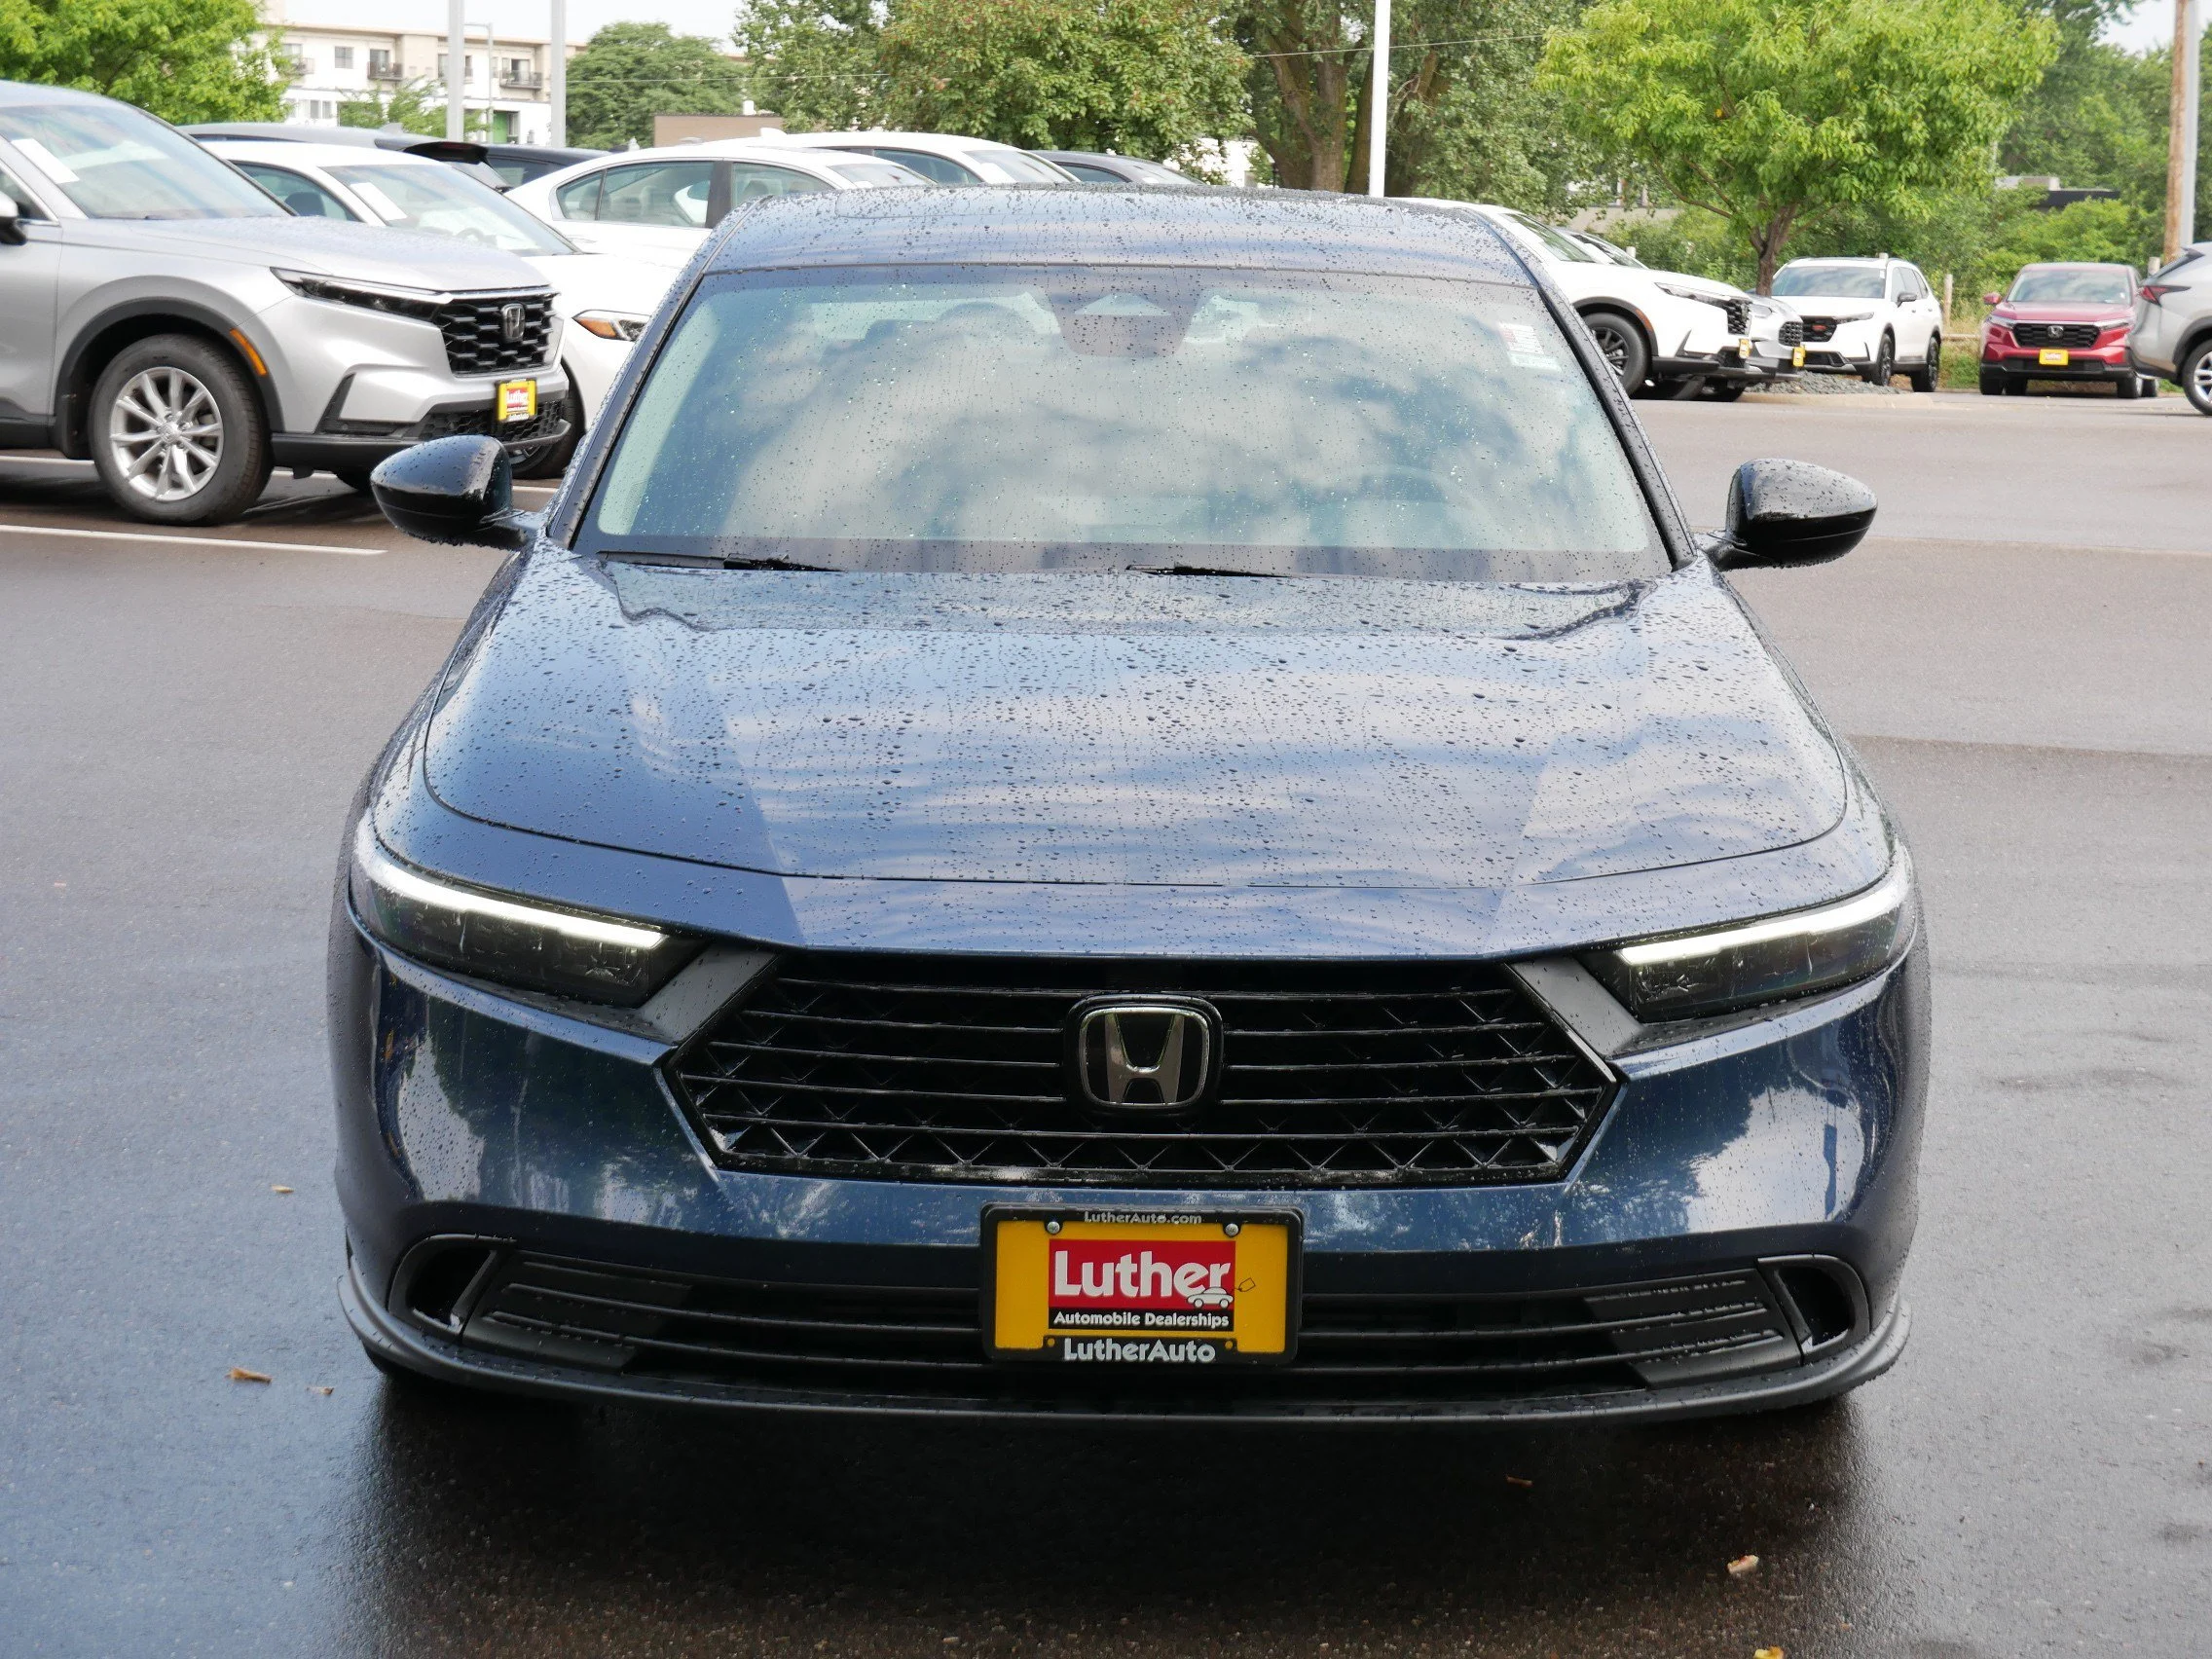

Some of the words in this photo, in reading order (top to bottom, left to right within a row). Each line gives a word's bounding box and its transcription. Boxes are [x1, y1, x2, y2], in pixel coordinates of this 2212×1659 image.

[1084, 1210, 1202, 1224] LutherAuto.com
[1054, 1250, 1231, 1297] Luther
[1053, 1310, 1141, 1325] Automobile
[1144, 1312, 1230, 1329] Dealerships
[1064, 1338, 1216, 1362] LutherAuto
